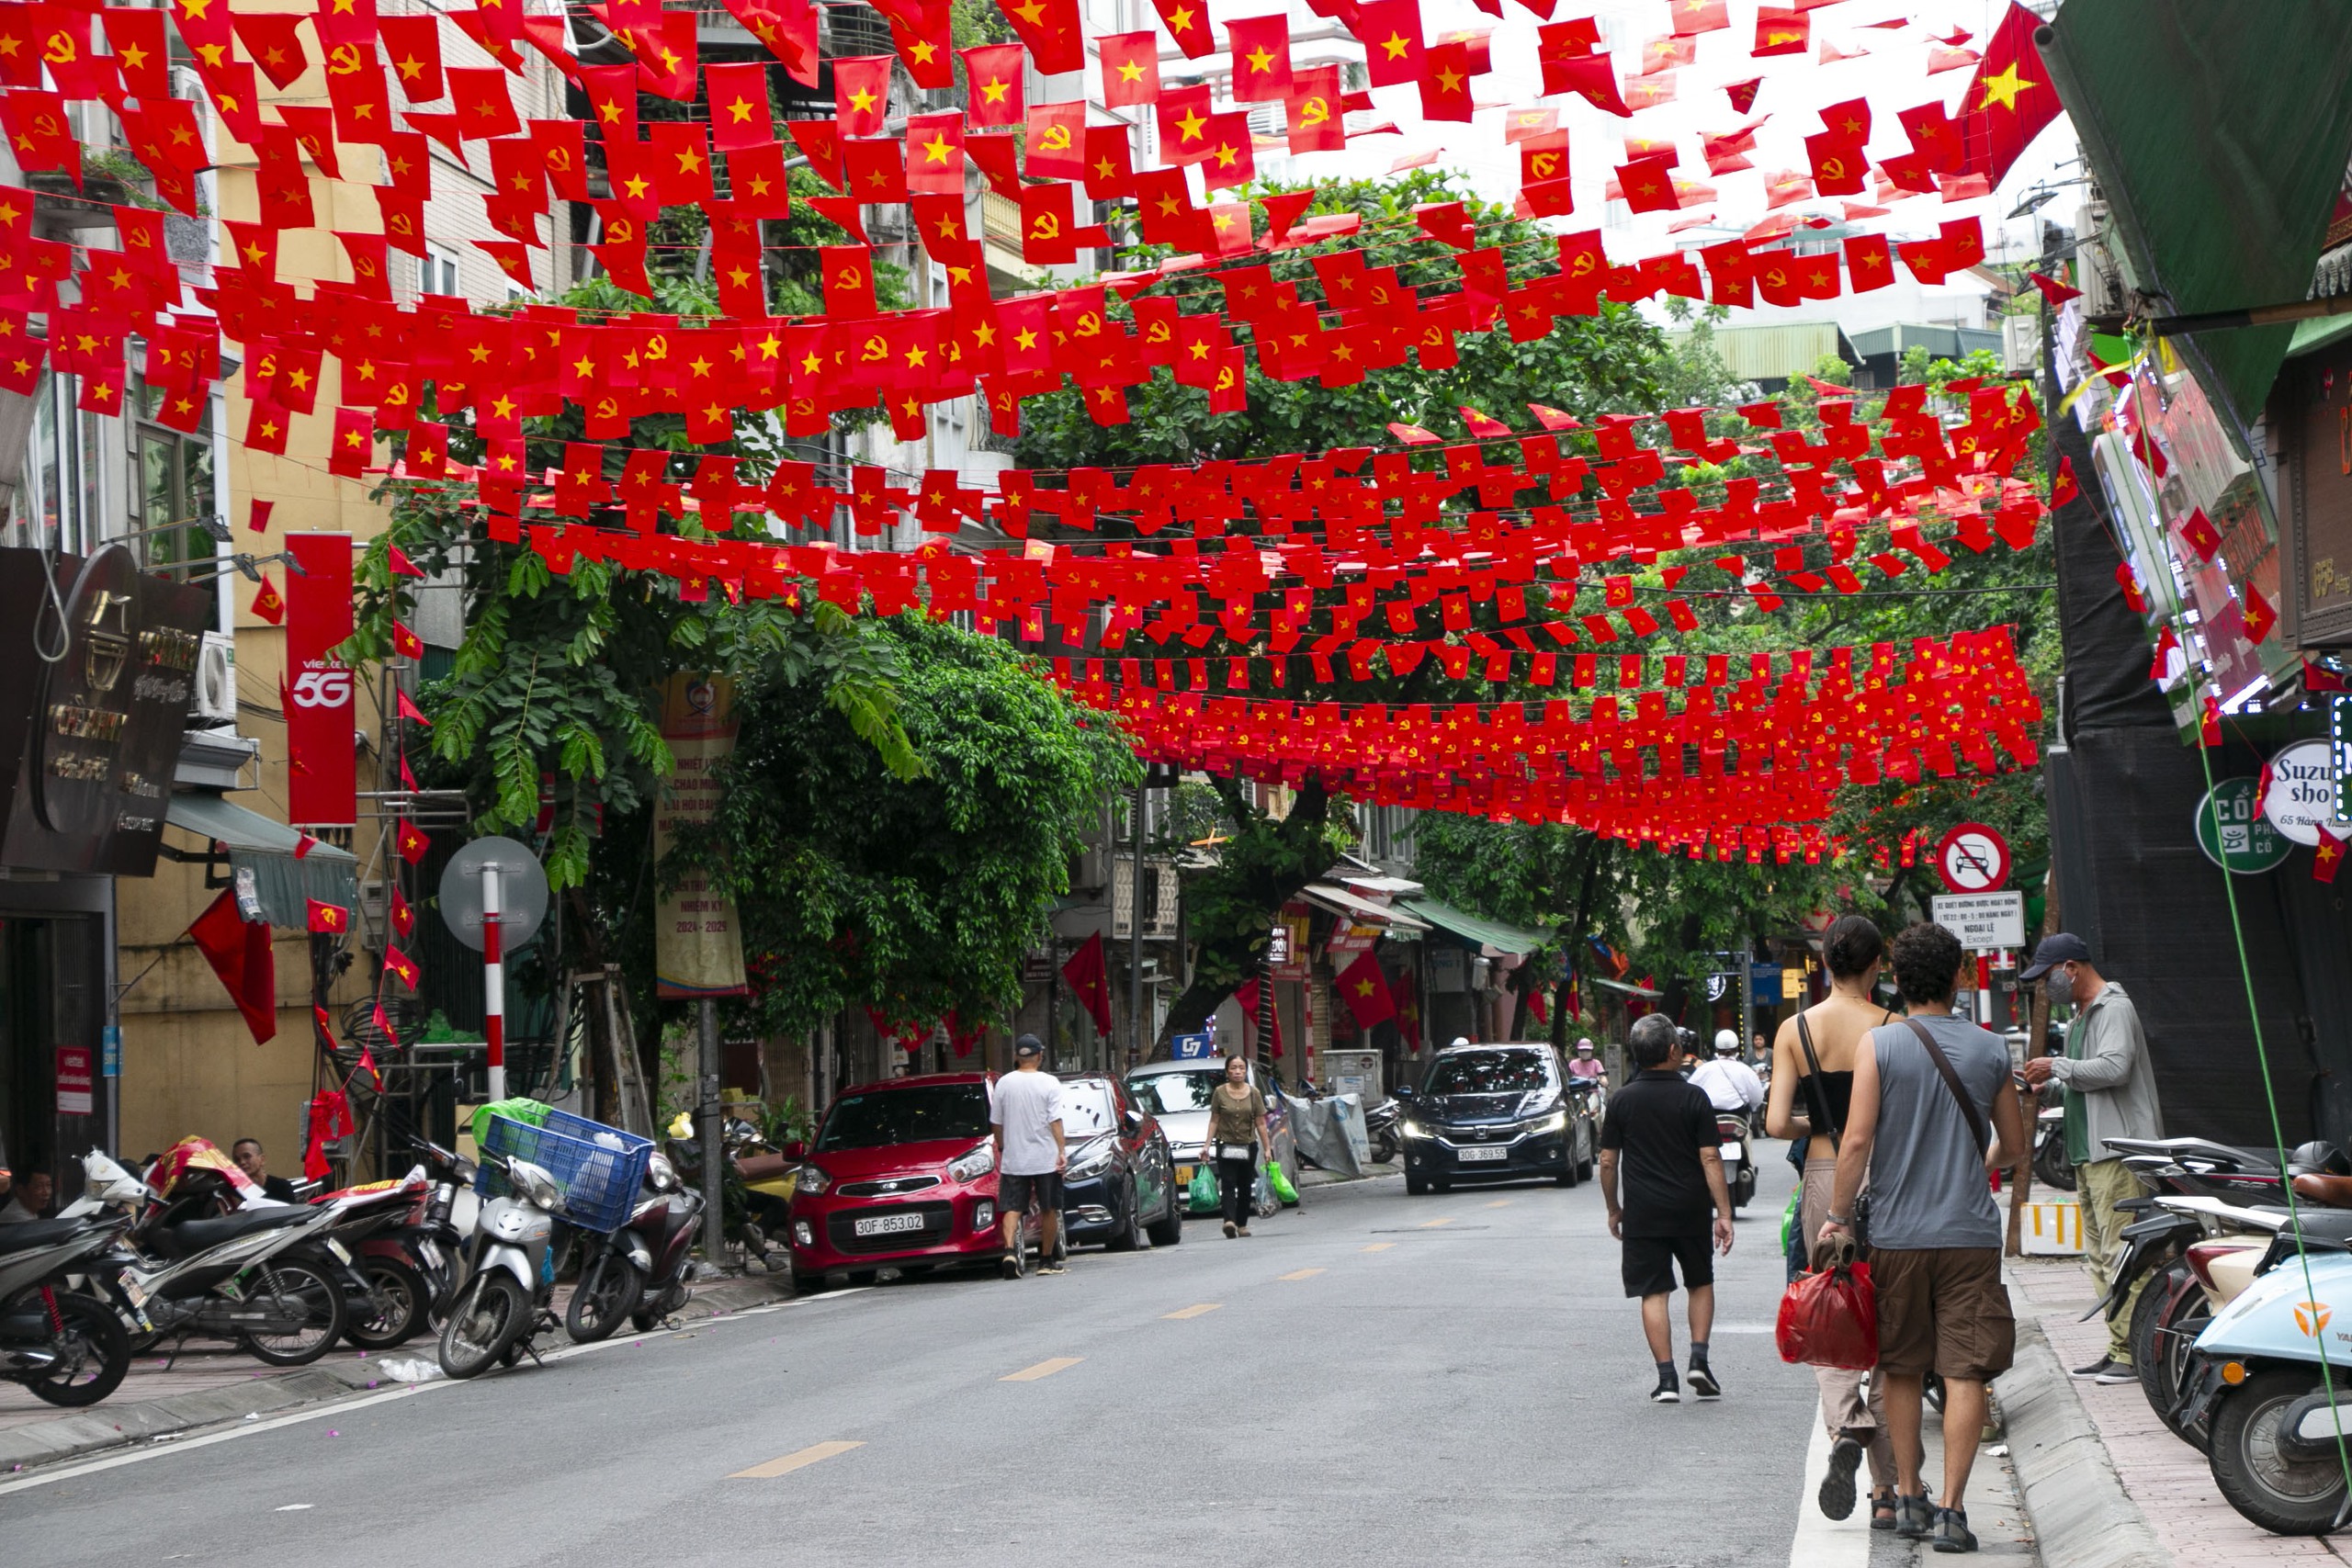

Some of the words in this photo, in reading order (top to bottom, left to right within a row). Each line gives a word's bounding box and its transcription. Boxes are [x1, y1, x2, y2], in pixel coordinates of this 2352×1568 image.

[293, 672, 350, 707] 5G
[2280, 815, 2293, 825] 65
[676, 920, 697, 932] 2024
[706, 920, 727, 932] 2029
[1964, 924, 1984, 934] NGOẠI
[1966, 935, 1994, 943] Except
[1182, 1037, 1202, 1056] G7
[857, 1215, 922, 1235] 30F-853.02
